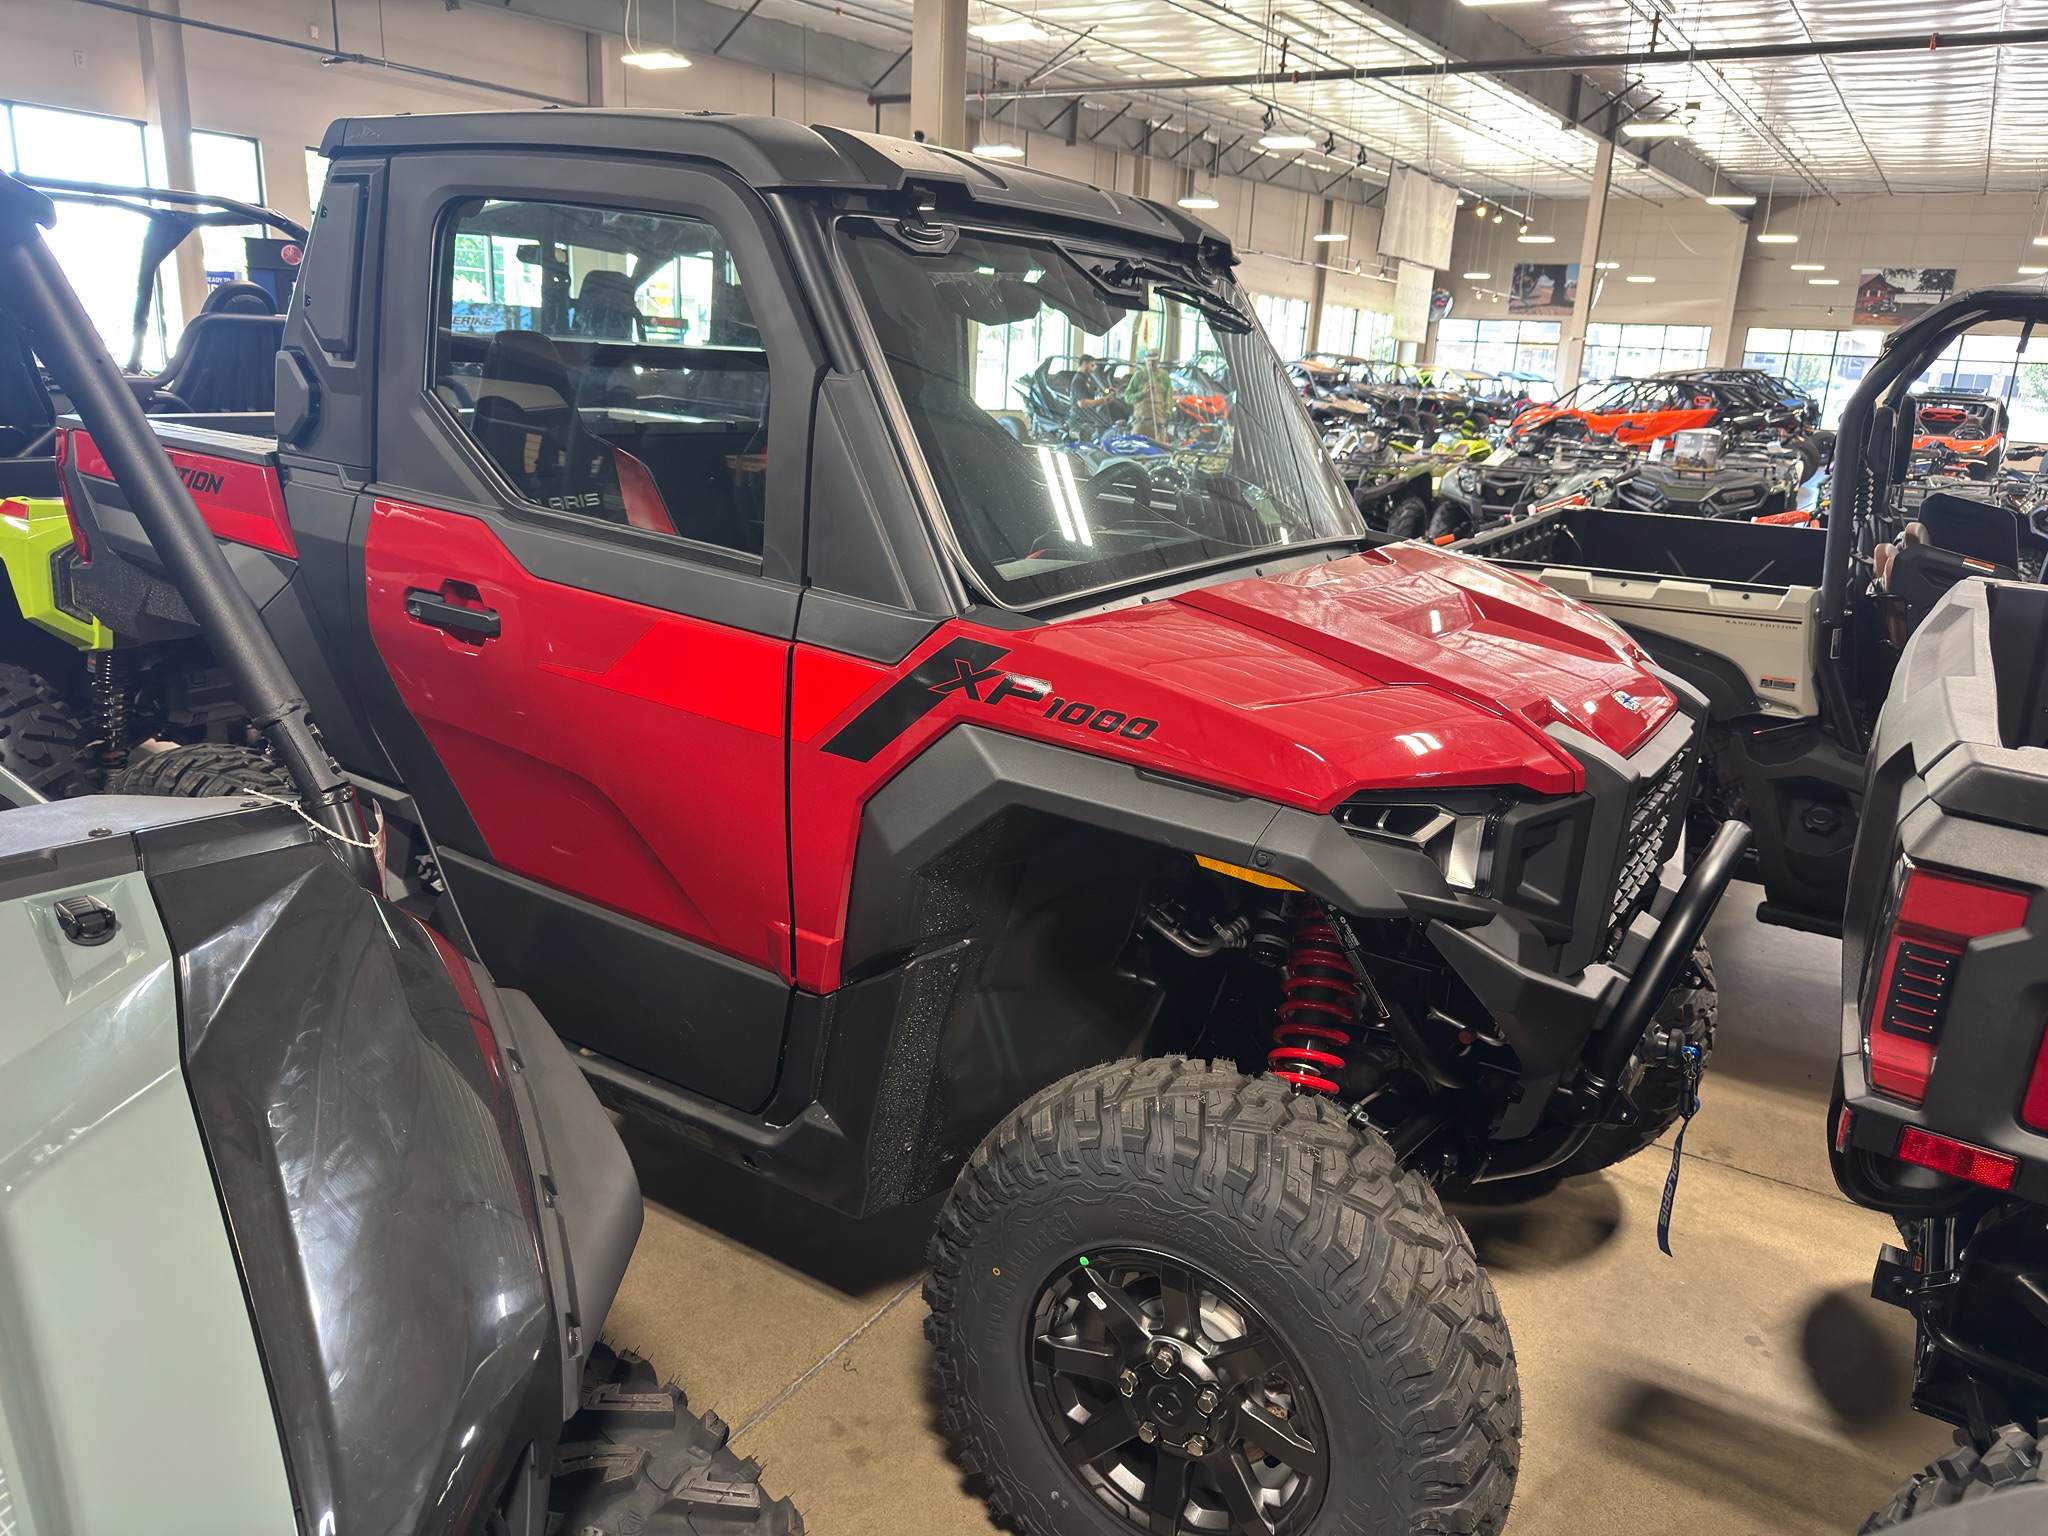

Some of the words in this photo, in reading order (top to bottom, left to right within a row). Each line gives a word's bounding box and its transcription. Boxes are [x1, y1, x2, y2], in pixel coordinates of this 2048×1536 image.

[174, 466, 225, 495] TION
[1725, 619, 1757, 627] RANCH
[1043, 697, 1159, 740] 1000
[1660, 1145, 1679, 1228] POLARIS
